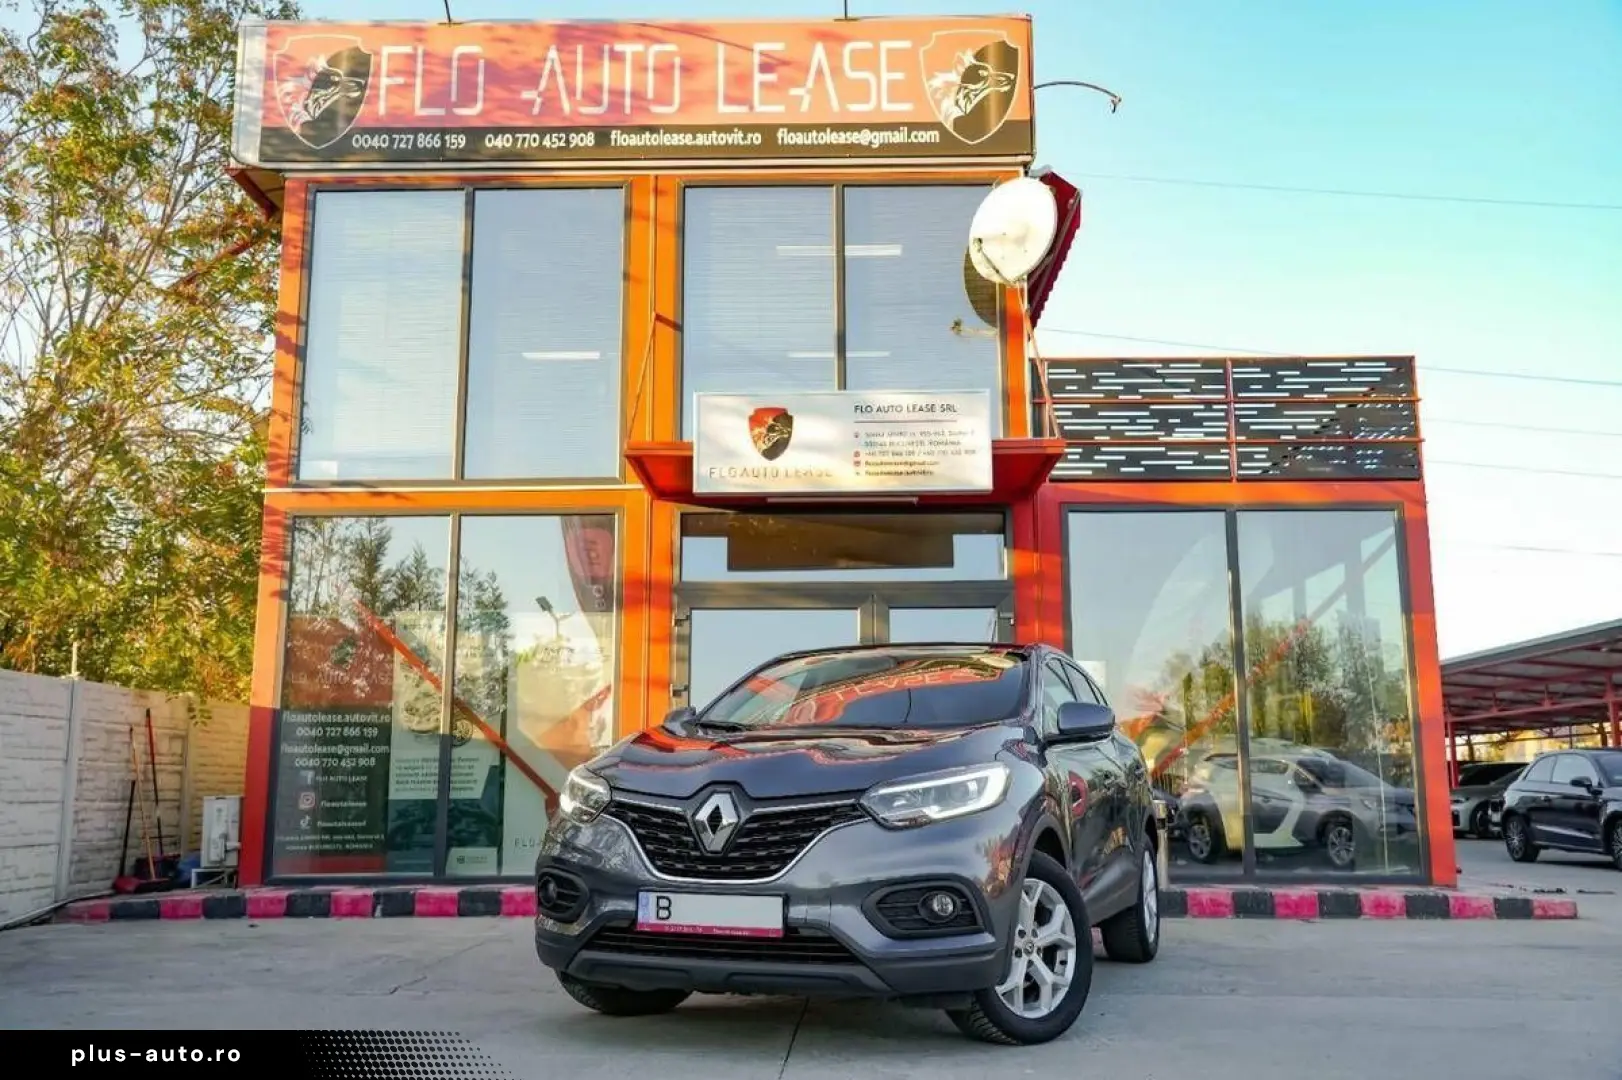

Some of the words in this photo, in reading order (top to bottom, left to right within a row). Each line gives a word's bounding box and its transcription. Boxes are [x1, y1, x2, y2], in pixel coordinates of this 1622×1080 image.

[379, 44, 486, 116] FLO
[520, 42, 683, 116] AUTO
[717, 40, 914, 114] LEASE
[352, 133, 389, 149] 0040
[391, 133, 415, 150] 727
[417, 132, 442, 149] 866
[445, 132, 466, 149] 159
[485, 131, 513, 148] 040
[515, 131, 540, 149] 770
[541, 131, 567, 148] 452
[569, 130, 596, 148] 908
[610, 128, 762, 147] floautolease.autovit.ro
[776, 126, 940, 149] floautolease@gmail.com
[853, 404, 874, 414] FLO
[876, 403, 904, 413] AUTO
[906, 403, 936, 413] LEASE
[940, 403, 958, 413] SRL
[656, 895, 673, 921] B
